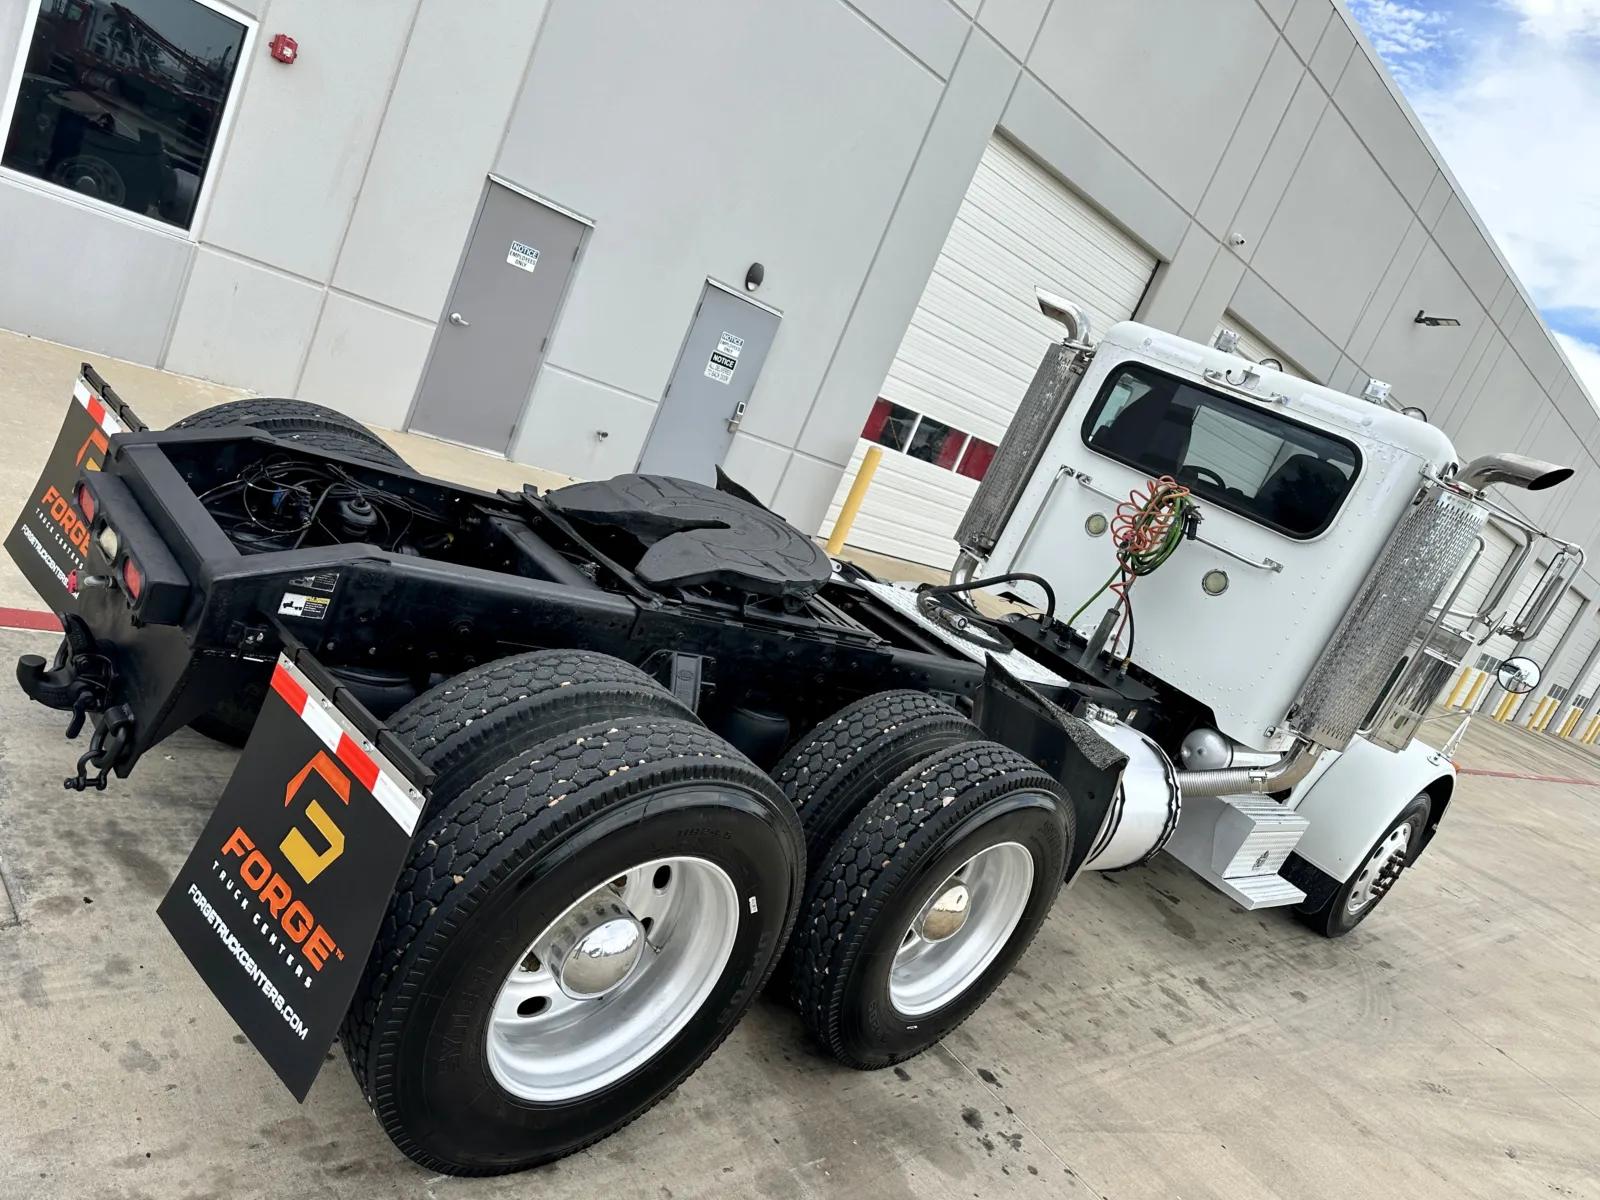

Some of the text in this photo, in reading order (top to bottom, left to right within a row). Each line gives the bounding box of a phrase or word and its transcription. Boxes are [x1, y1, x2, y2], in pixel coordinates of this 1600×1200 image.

[511, 242, 538, 260] NOTICE
[712, 354, 735, 368] NOTICE
[722, 333, 743, 347] NOTICE
[36, 508, 83, 570] TRUCK CENTERS
[41, 486, 91, 558] FORGE
[212, 860, 312, 988] TRUCK CENTERS
[221, 827, 336, 972] FORGE
[188, 883, 309, 1040] FORGETRUCKCENTERS.COM
